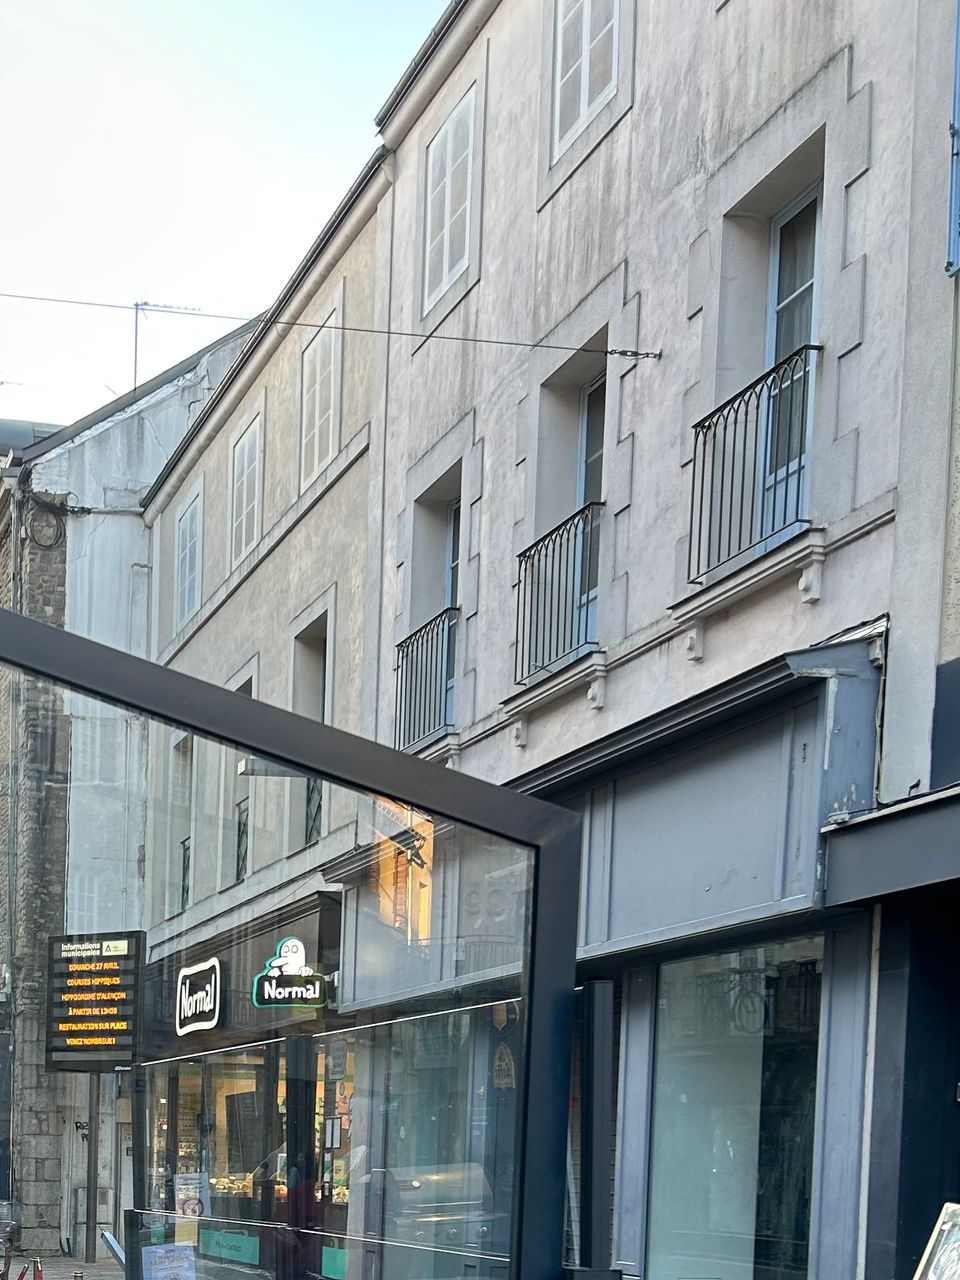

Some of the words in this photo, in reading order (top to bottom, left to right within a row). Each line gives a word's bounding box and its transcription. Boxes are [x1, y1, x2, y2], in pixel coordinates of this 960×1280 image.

[61, 943, 100, 951] Informations
[61, 949, 100, 957] municipales
[67, 978, 91, 986] COURSES
[91, 977, 120, 986] HIPPIQUES
[264, 979, 320, 999] Normal
[61, 993, 96, 1001] HIPPODROME
[181, 973, 215, 1020] Normal
[59, 1023, 98, 1031] RESTAURATION
[99, 1022, 109, 1030] SUR
[110, 1021, 127, 1030] PLACE
